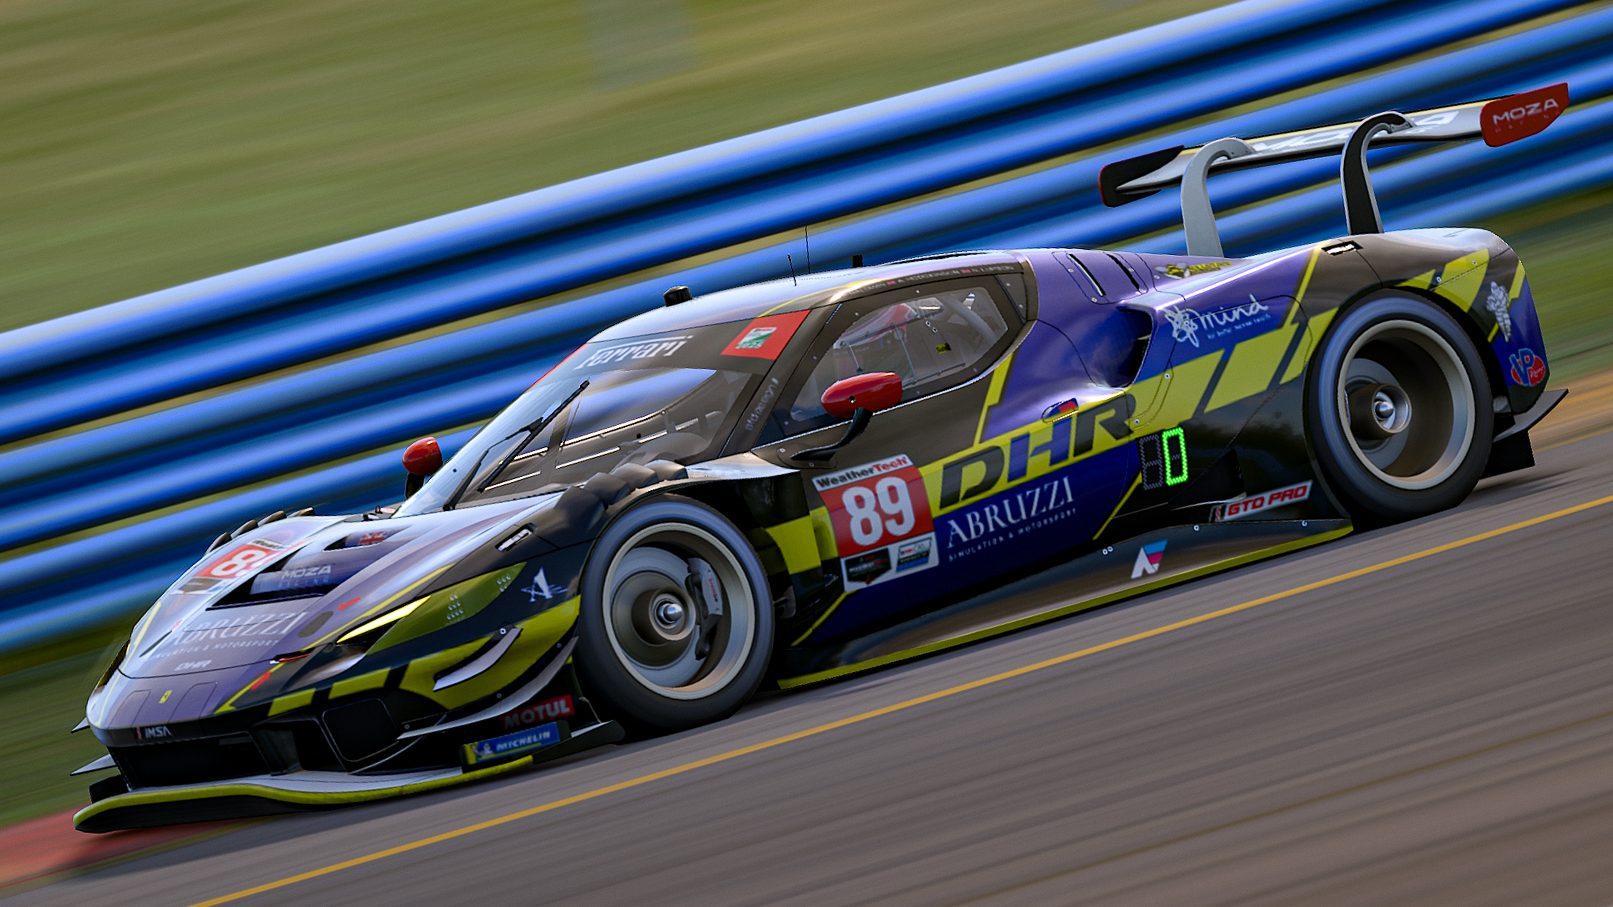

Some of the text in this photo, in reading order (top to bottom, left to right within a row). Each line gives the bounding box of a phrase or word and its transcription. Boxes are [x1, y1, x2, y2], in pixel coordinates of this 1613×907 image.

[1492, 98, 1559, 126] MOZA
[1199, 294, 1269, 330] mind
[573, 335, 694, 370] Ferrari
[939, 393, 1137, 510] DHR
[816, 456, 909, 489] WeatherTech
[1267, 484, 1308, 506] PRO
[842, 476, 916, 547] 89
[945, 475, 1075, 549] ABRUZZI
[280, 565, 332, 580] MOZA
[503, 700, 571, 729] MOTUL
[144, 725, 172, 739] IMSA
[496, 731, 552, 752] MICHELIN
